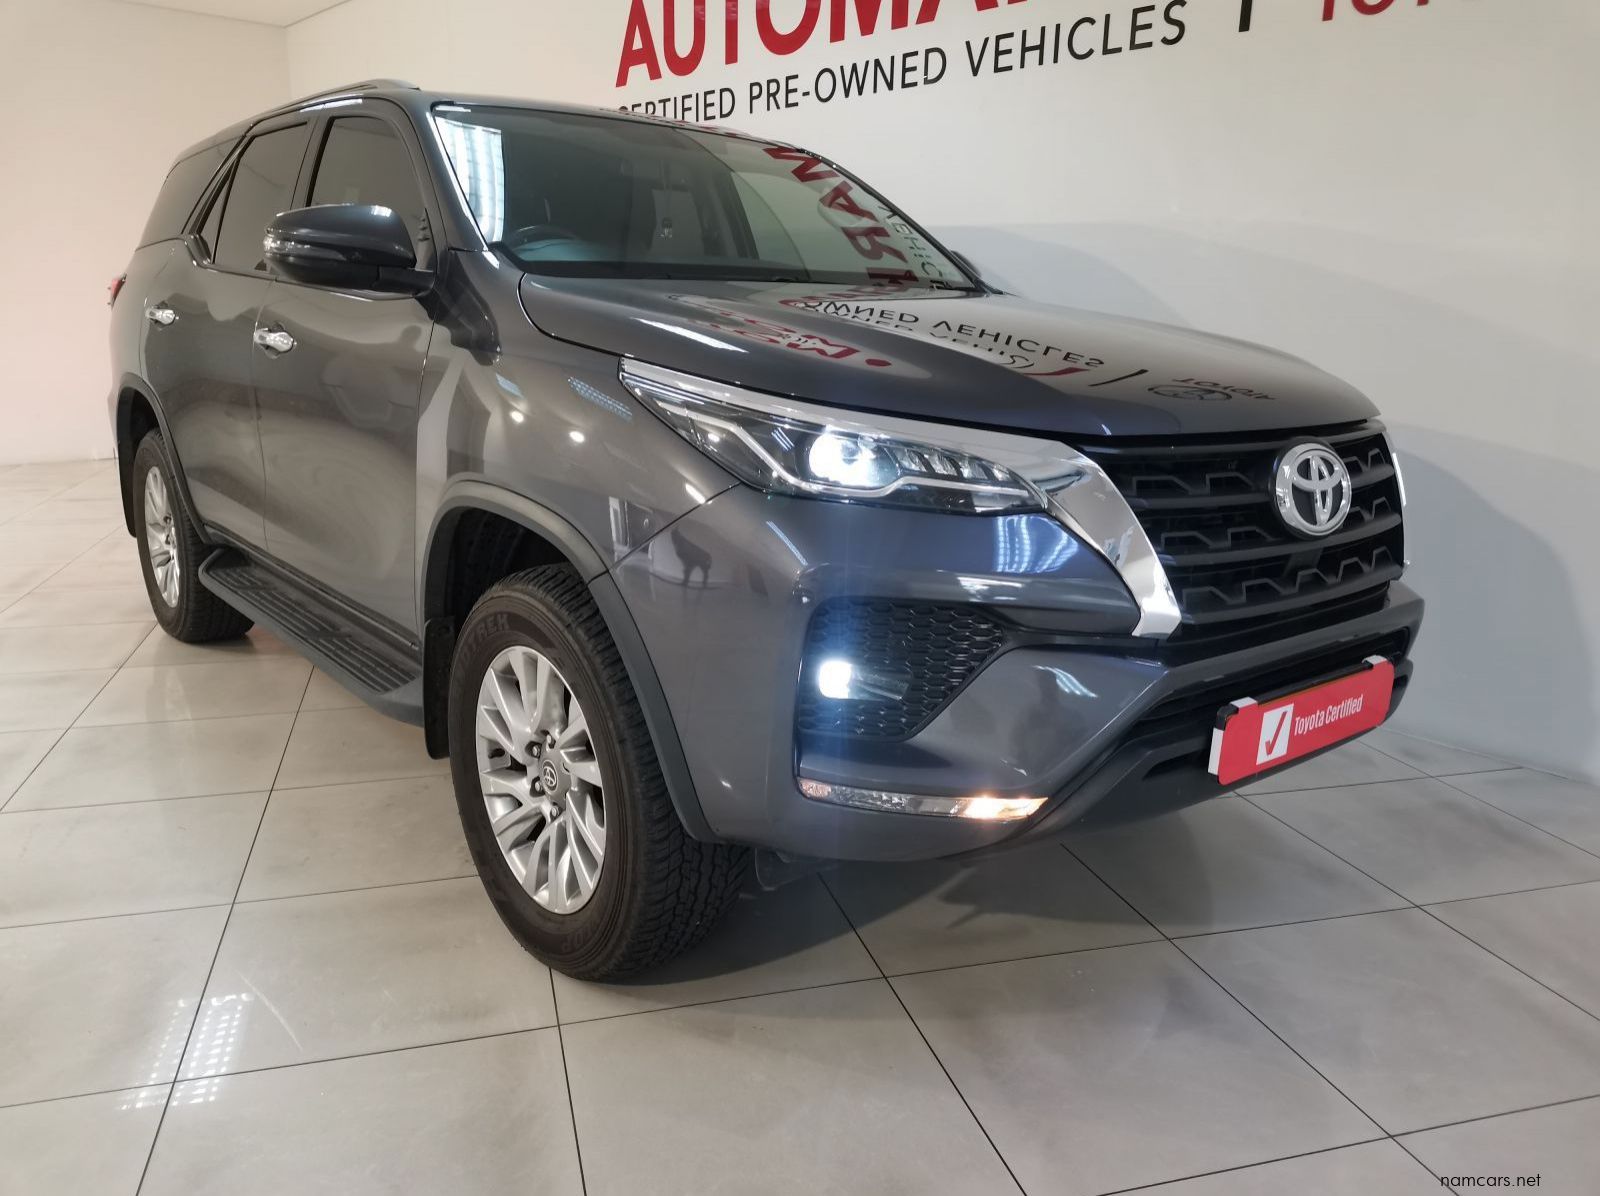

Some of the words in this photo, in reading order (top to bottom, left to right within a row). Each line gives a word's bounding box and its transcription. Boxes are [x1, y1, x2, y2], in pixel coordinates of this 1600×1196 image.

[749, 47, 947, 114] PRE-OWNED
[965, 0, 1187, 77] VEHICLES
[1294, 709, 1325, 736] Toyota
[1325, 694, 1363, 723] Certified
